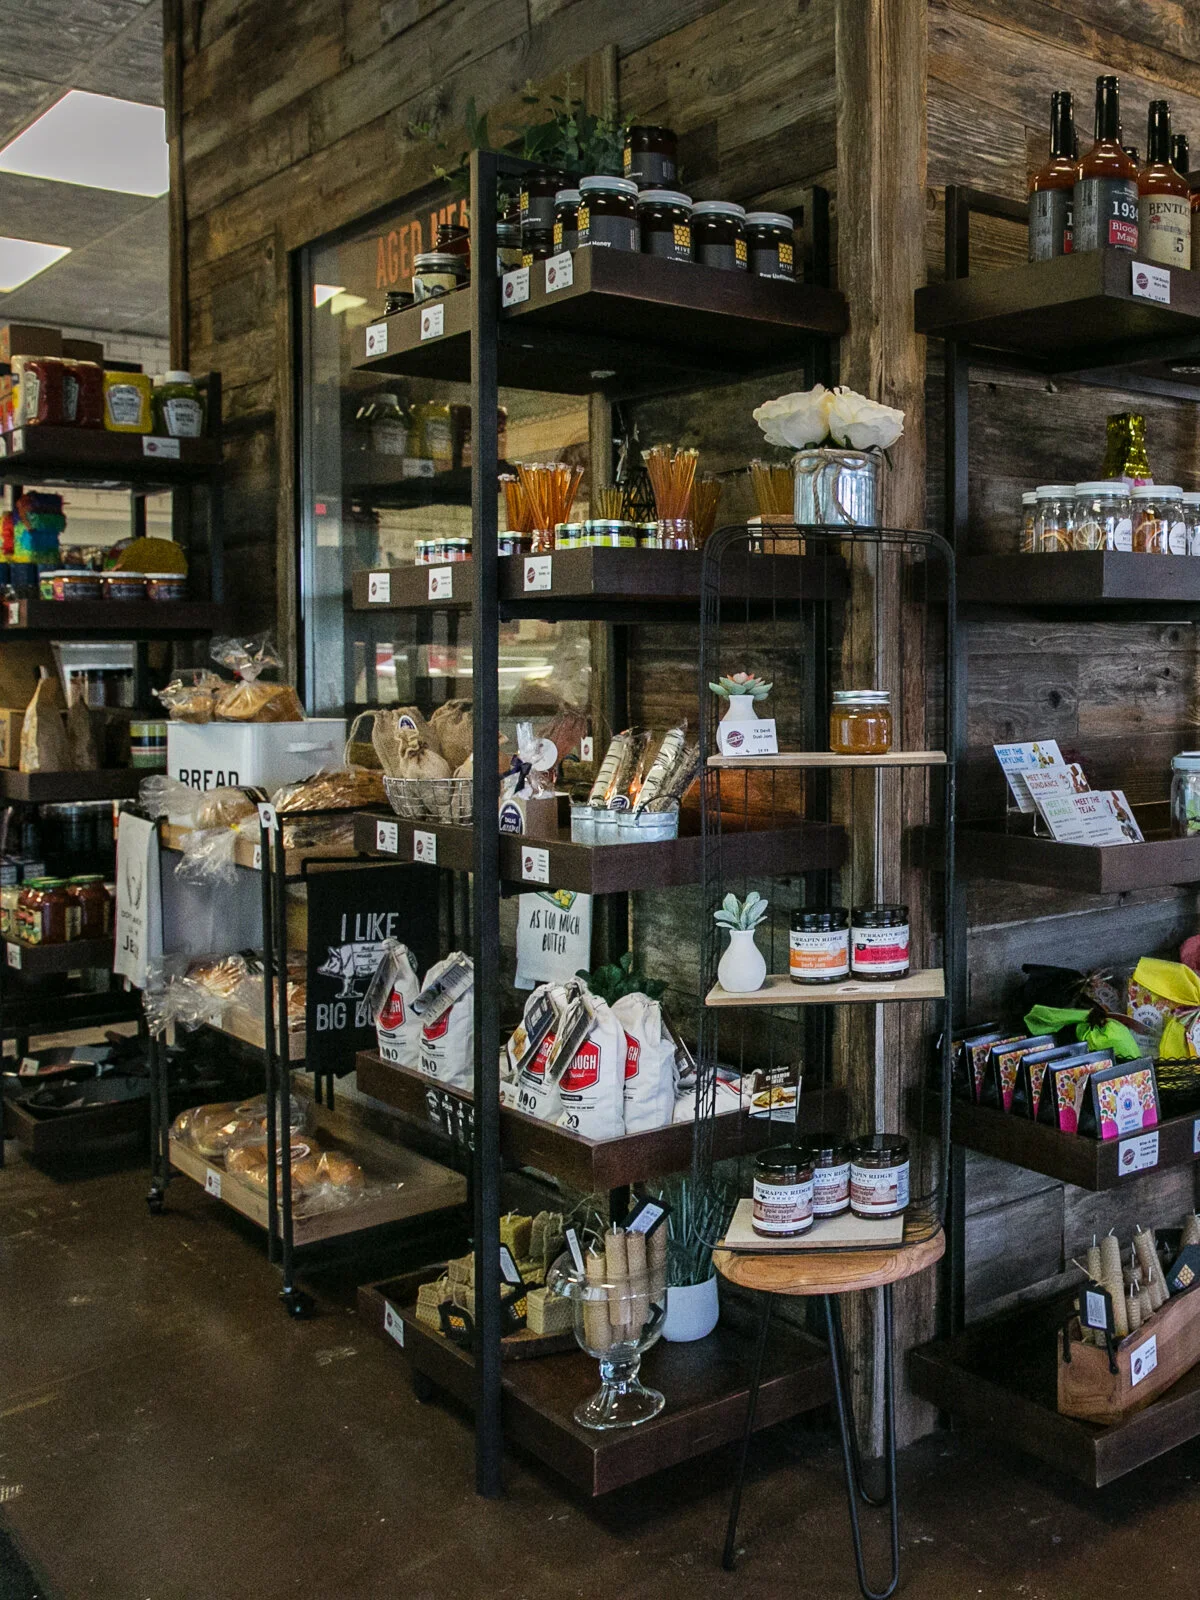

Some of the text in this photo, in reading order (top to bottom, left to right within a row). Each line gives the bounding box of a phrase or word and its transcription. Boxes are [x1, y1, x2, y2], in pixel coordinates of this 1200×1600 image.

[1117, 231, 1137, 244] Mary
[376, 220, 423, 289] AGED
[674, 245, 691, 254] HIVE
[998, 747, 1024, 756] MEET THE
[1000, 756, 1025, 765] SKYLINE
[179, 768, 240, 792] BREAD
[1026, 772, 1052, 782] MEET THE
[1075, 795, 1101, 806] MEET THE
[1047, 807, 1073, 817] RAMBLE
[1077, 806, 1097, 815] TEJAS
[340, 912, 399, 942] I LIKE
[529, 909, 580, 936] AS TOO MUCH
[541, 932, 568, 955] BUTTER
[316, 1001, 347, 1032] BIG
[568, 1054, 597, 1070] OUGH
[755, 1186, 811, 1197] TERRAPIN RIDGE
